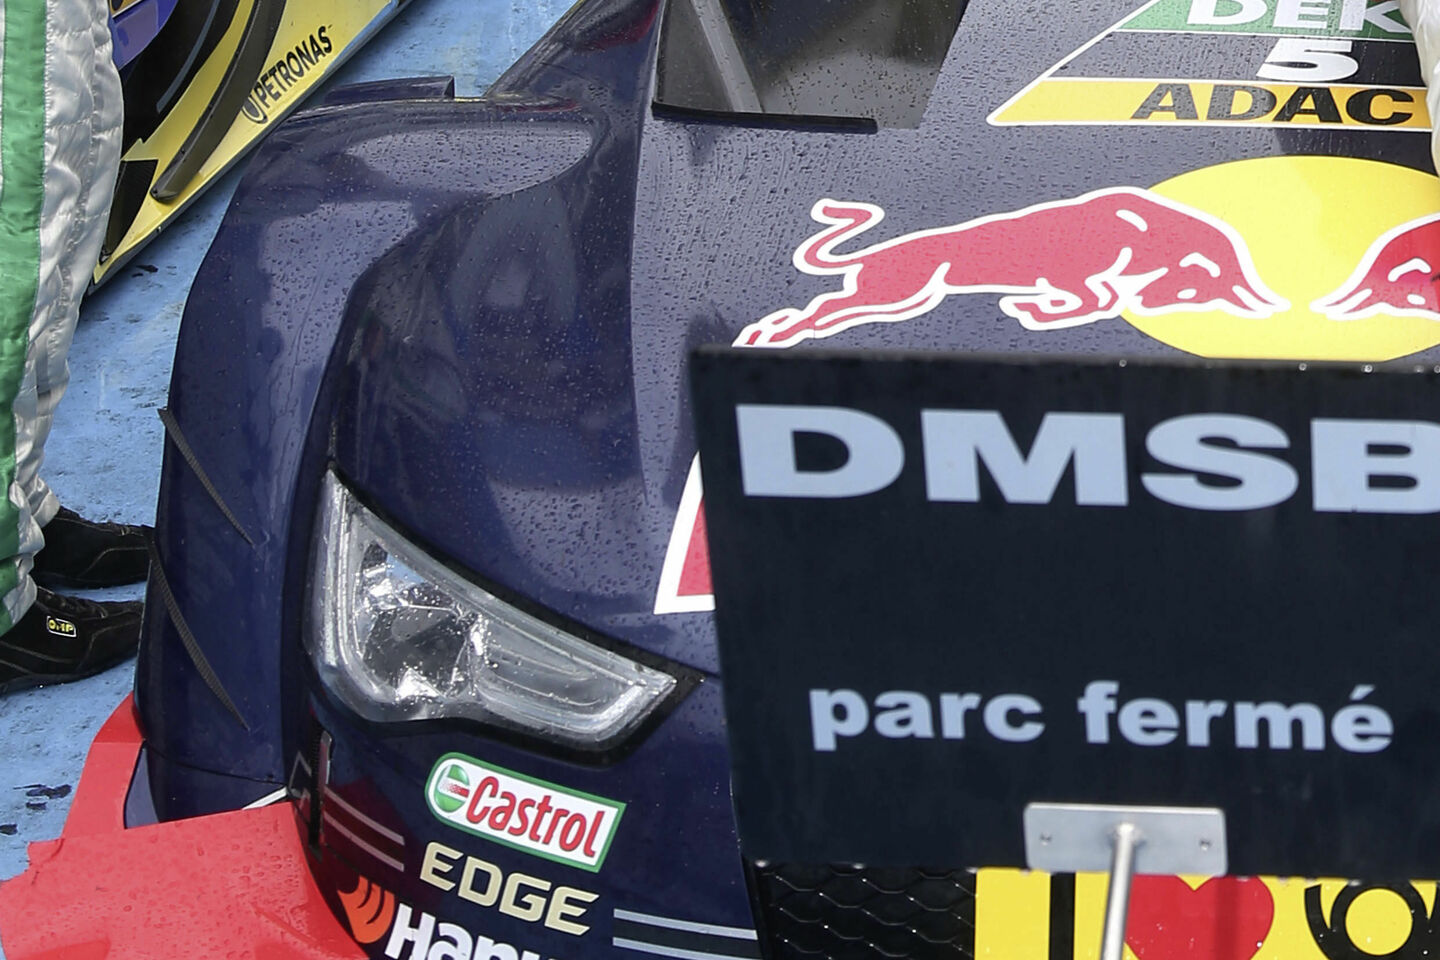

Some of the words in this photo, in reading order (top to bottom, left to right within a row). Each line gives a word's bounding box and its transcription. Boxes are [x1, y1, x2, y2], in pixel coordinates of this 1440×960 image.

[257, 24, 334, 110] PETRONAS
[1255, 38, 1360, 82] 5
[1130, 82, 1415, 125] ADAC
[48, 618, 75, 634] OMP
[809, 686, 1047, 752] parc
[1077, 680, 1396, 755] fermé
[465, 775, 606, 858] Castrol
[419, 841, 600, 937] EDGE
